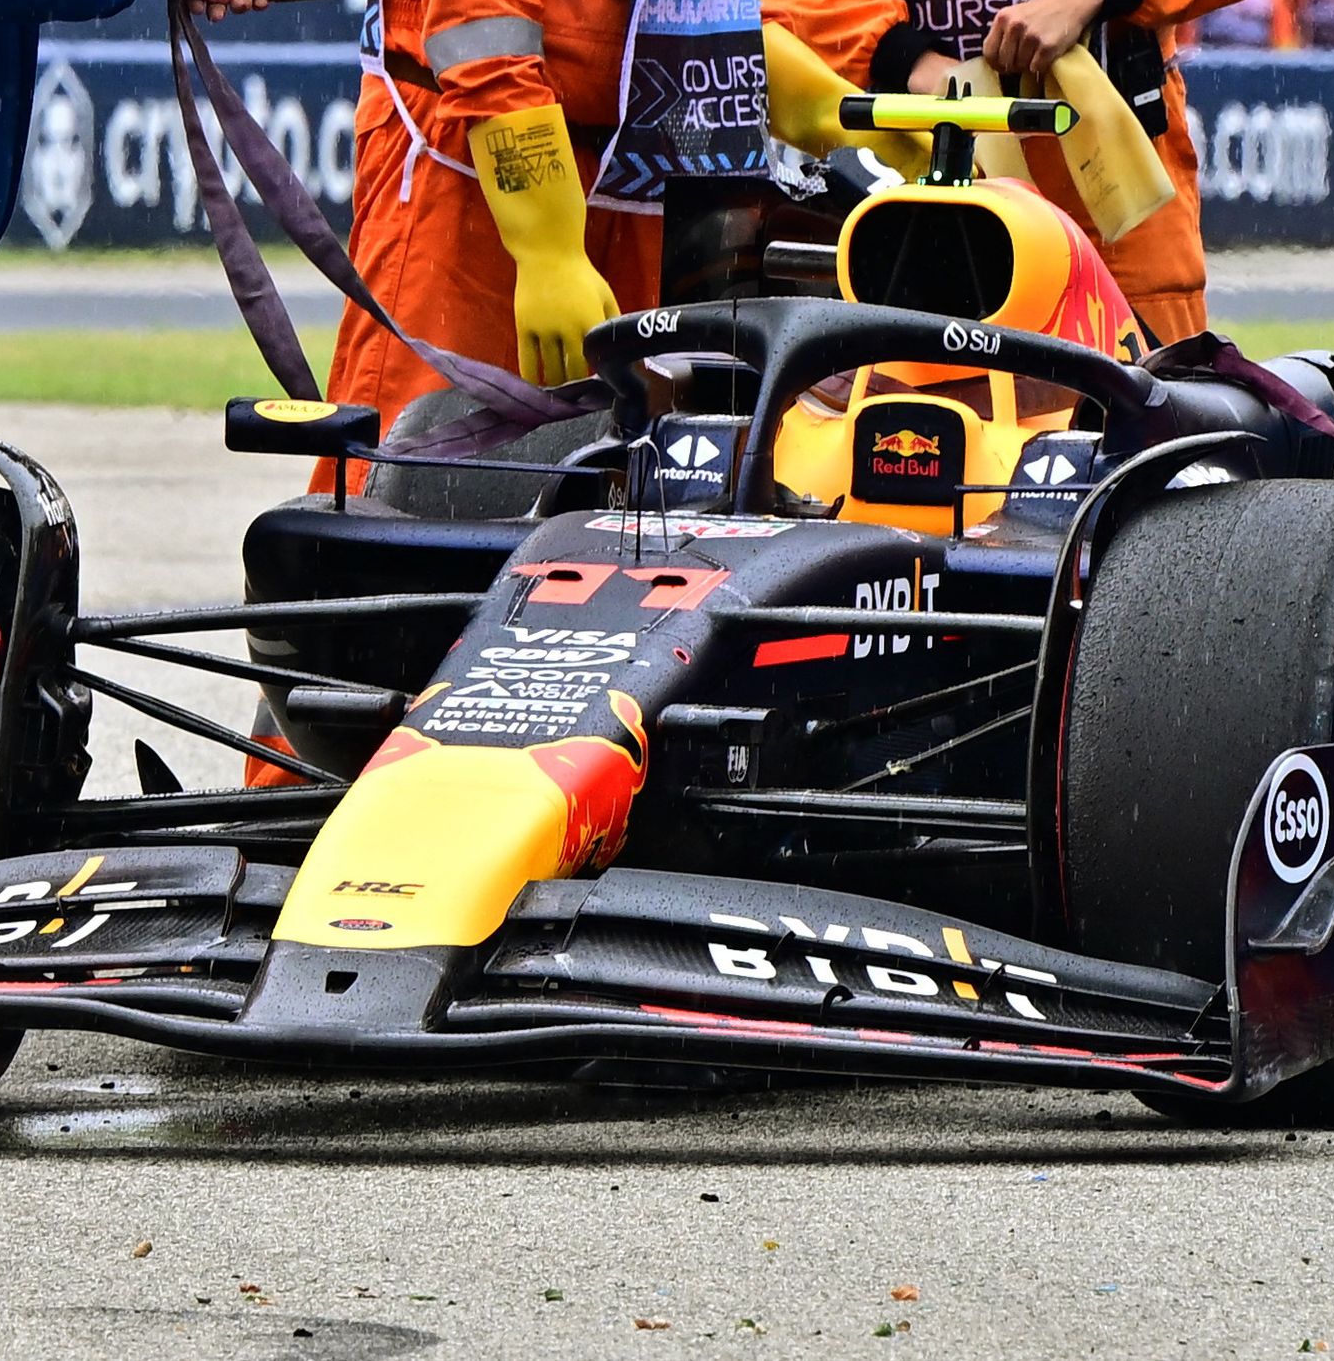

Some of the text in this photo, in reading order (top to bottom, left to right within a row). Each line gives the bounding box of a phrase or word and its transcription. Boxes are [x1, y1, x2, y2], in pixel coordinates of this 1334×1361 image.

[654, 467, 724, 485] inter.mx
[873, 457, 939, 478] Red Bull
[503, 626, 637, 648] VISA
[508, 681, 603, 695] ARCTIC
[518, 688, 589, 701] WOLF
[422, 719, 530, 735] Mobil
[1274, 789, 1320, 844] Esso
[332, 880, 425, 896] HRC
